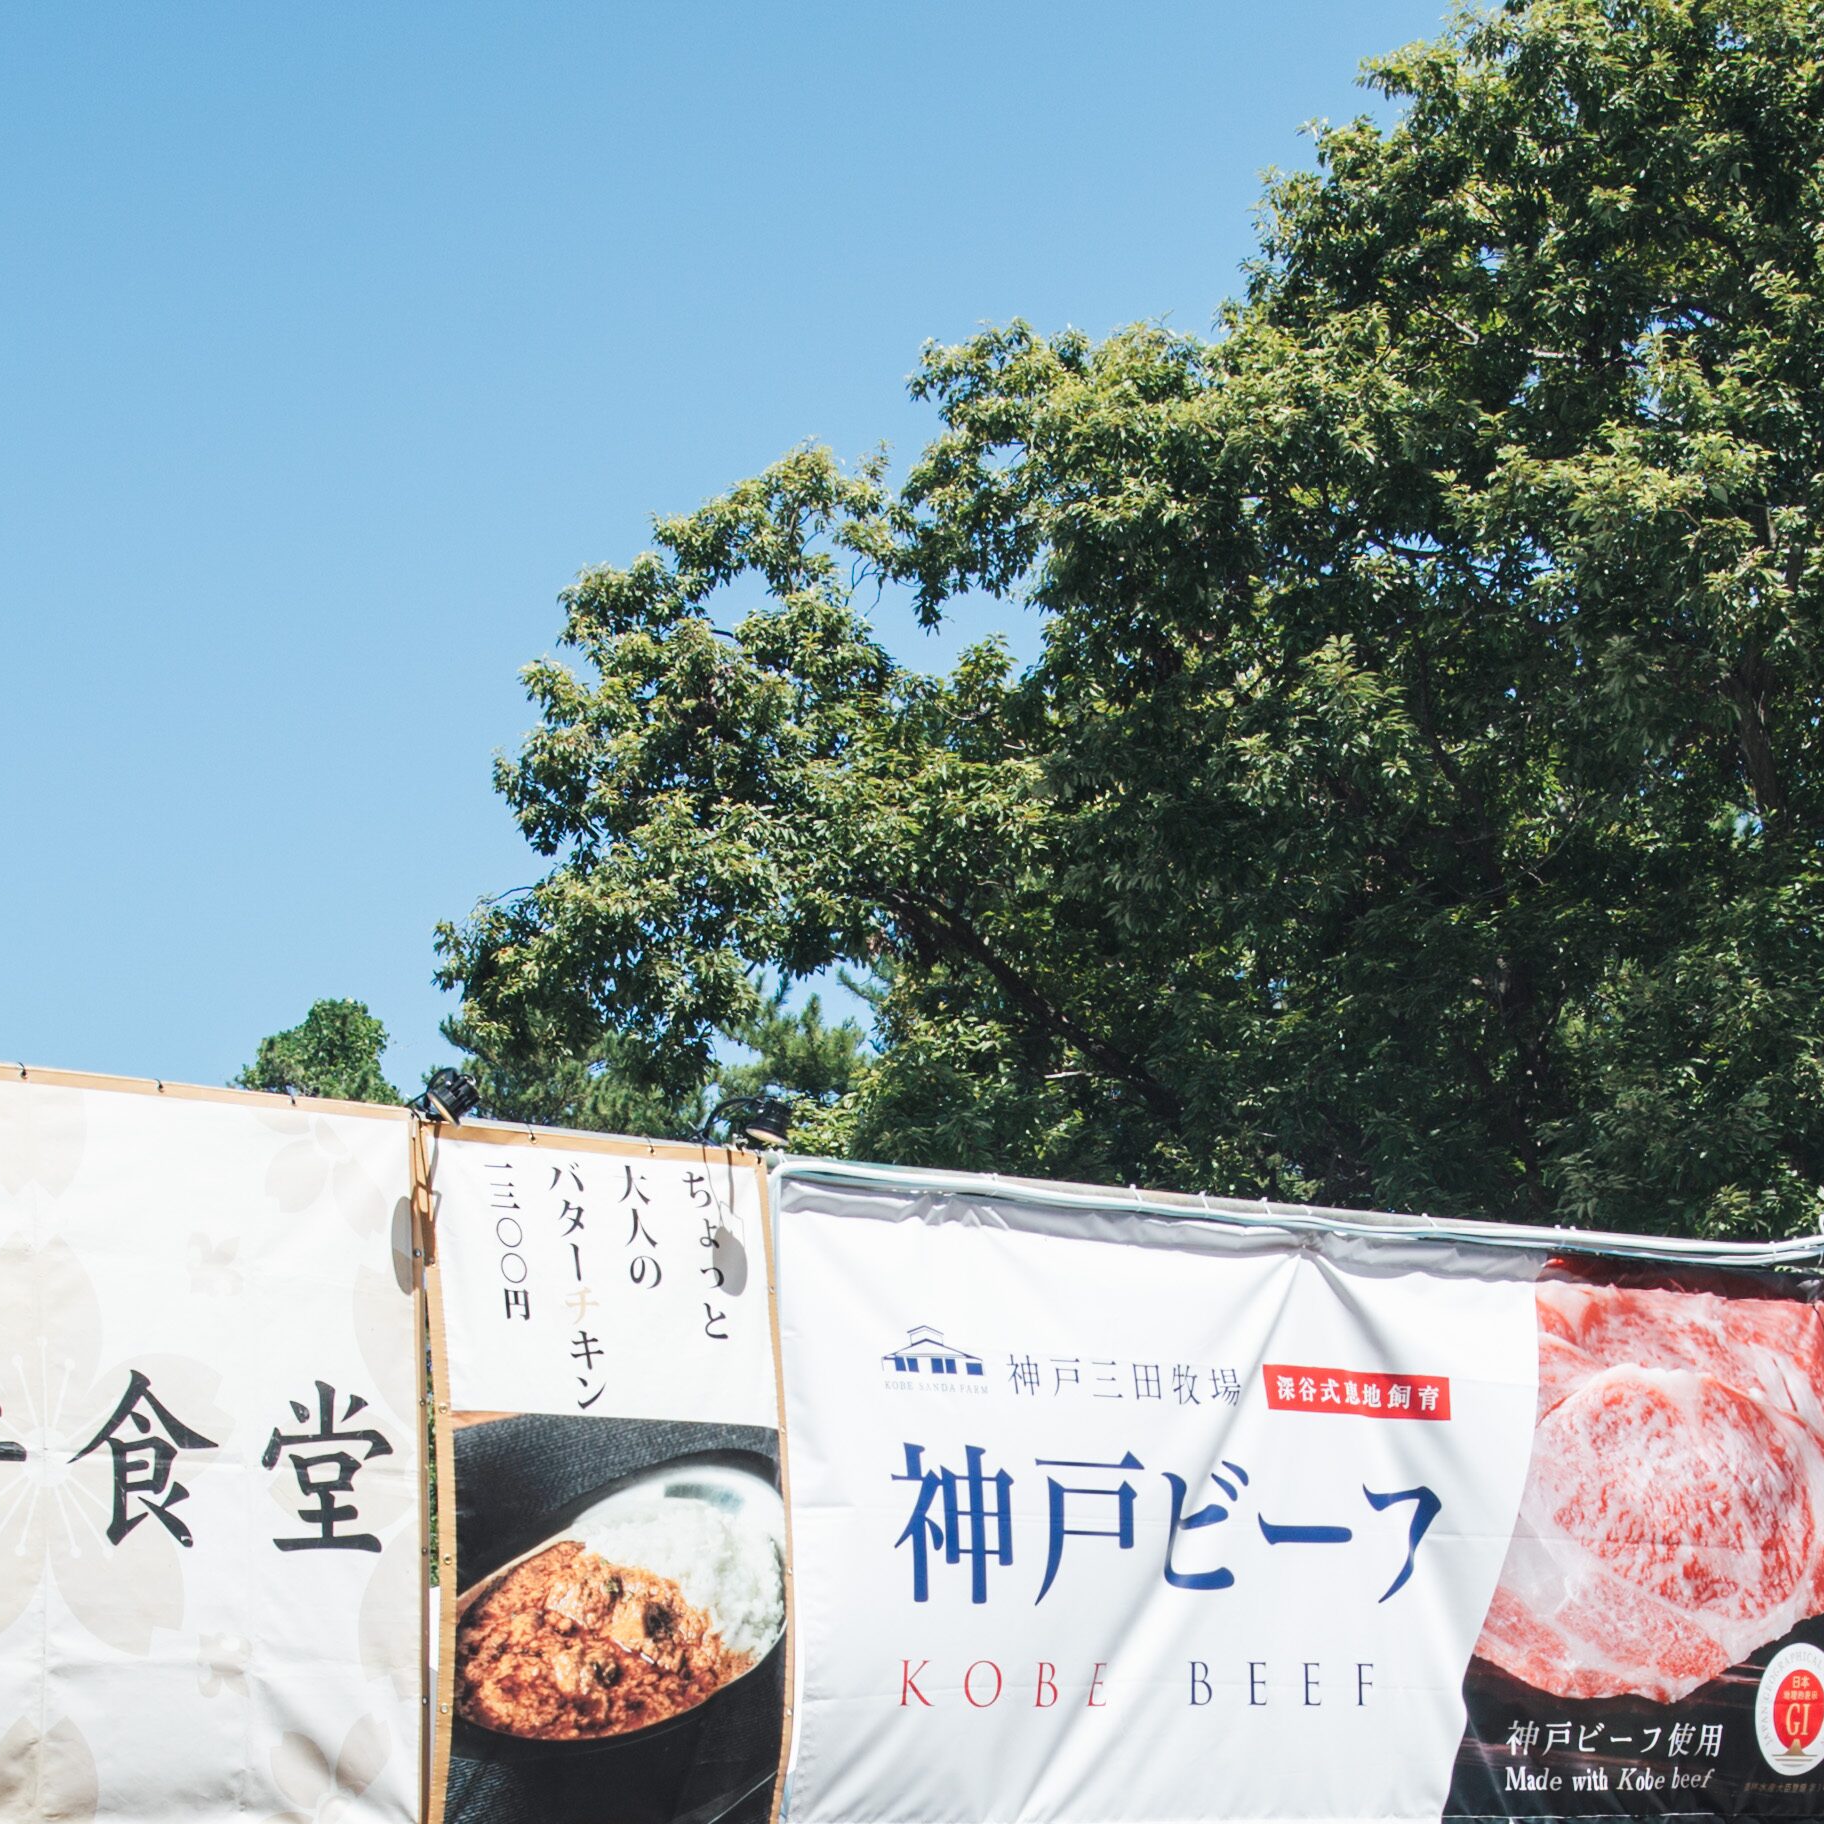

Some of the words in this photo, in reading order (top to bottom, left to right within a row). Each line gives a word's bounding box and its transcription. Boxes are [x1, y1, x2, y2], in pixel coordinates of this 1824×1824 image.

[614, 1165, 663, 1290] 大人の
[681, 1171, 730, 1340] ちょっと
[549, 1162, 607, 1410] バターチキン
[1006, 1353, 1242, 1407] 神戸三田牧場
[890, 1441, 1443, 1606] 神戸ビーフ
[898, 1660, 1110, 1709] KOBE
[1187, 1660, 1375, 1709] BEEF
[1791, 1675, 1811, 1690] 日本
[1505, 1719, 1725, 1759] 神戸ビーフ使用
[1785, 1702, 1812, 1736] GI
[1505, 1766, 1563, 1793] Made
[1572, 1766, 1609, 1793] with
[1616, 1766, 1665, 1792] Kobe
[1671, 1765, 1716, 1791] beef
